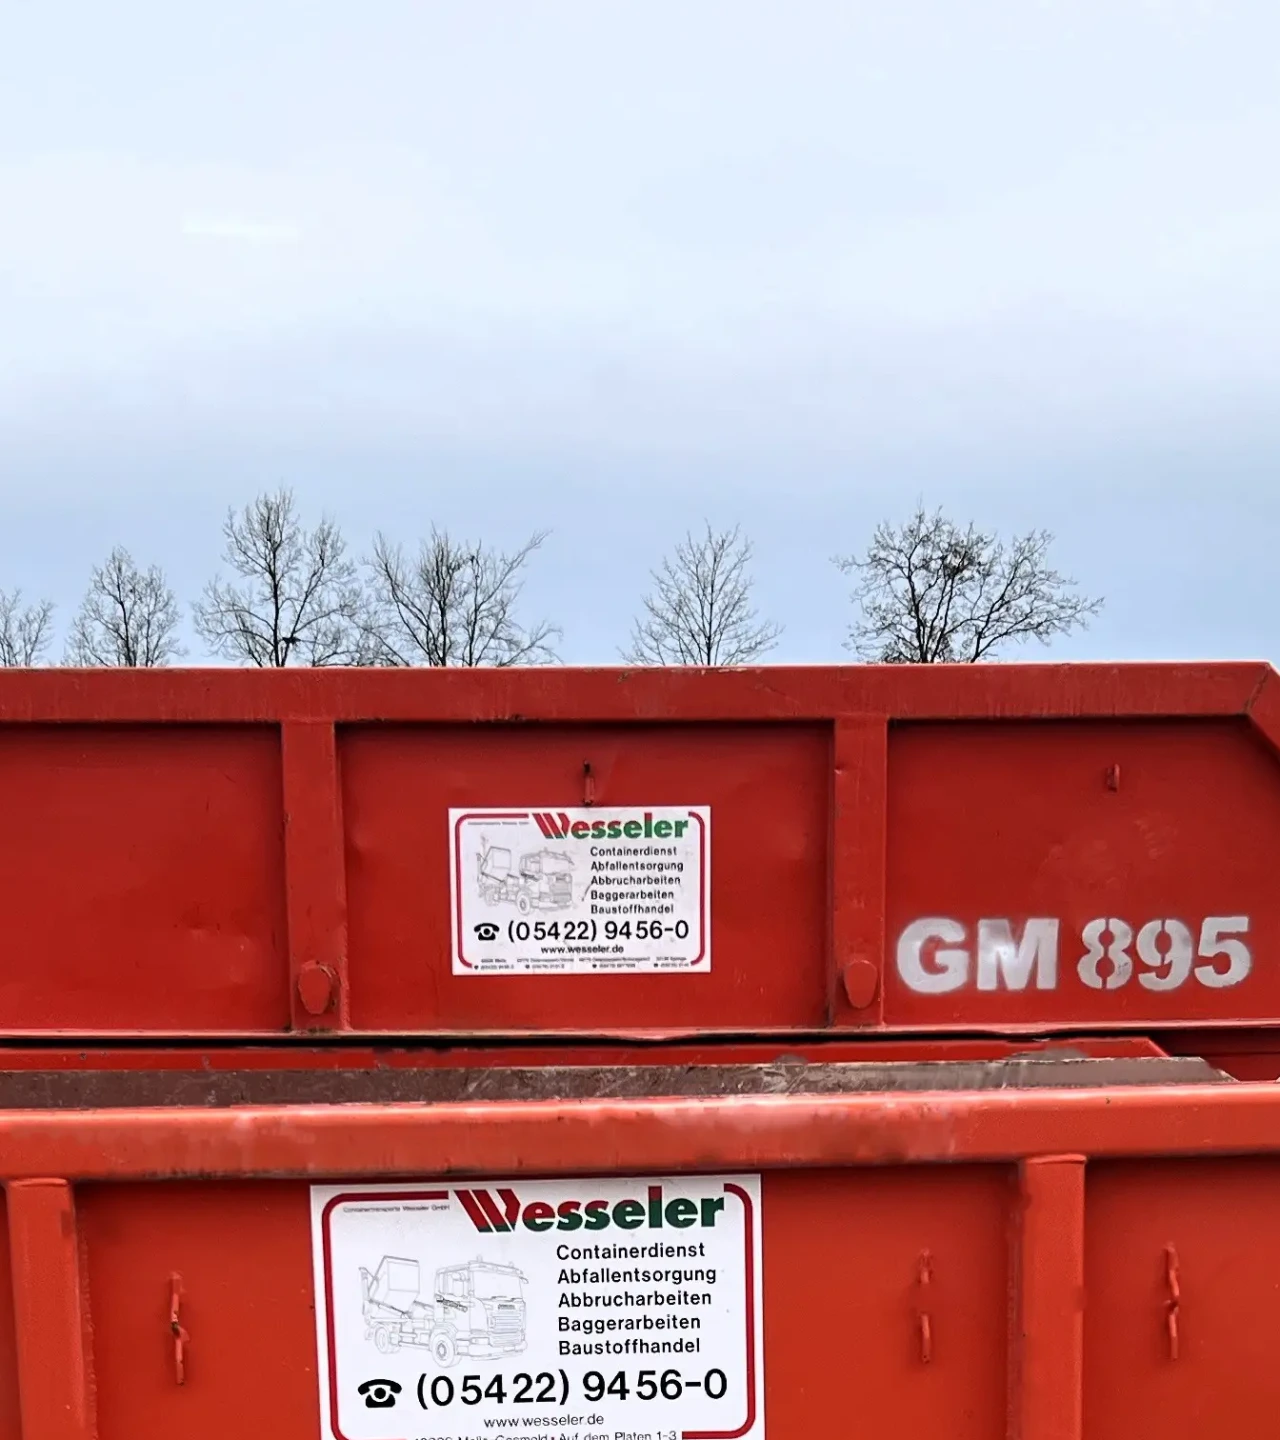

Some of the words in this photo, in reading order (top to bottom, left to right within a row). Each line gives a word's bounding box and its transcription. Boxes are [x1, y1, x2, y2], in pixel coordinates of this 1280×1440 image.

[532, 812, 689, 839] Wesseler
[590, 846, 677, 857] Containerdienst
[590, 861, 684, 873] Abfallentsorgung
[590, 875, 681, 886] Abbrucharbeiten
[590, 890, 674, 901] Baggerarbeiten
[590, 904, 674, 915] Baustoffhandel
[540, 944, 624, 954] www.wesseler.de
[896, 917, 1060, 994] GM
[1076, 916, 1251, 991] 895
[453, 1186, 724, 1233] Wesseler
[556, 1242, 705, 1260] Containerdienst
[557, 1266, 717, 1285] Abfallentsorgung
[558, 1291, 712, 1308] Abbrucharbeiten
[558, 1315, 701, 1334] Baggerarbeiten
[559, 1338, 701, 1356] Baustoffhandel
[484, 1414, 604, 1428] www.wesseler.de
[656, 1431, 677, 1440] 1-3
